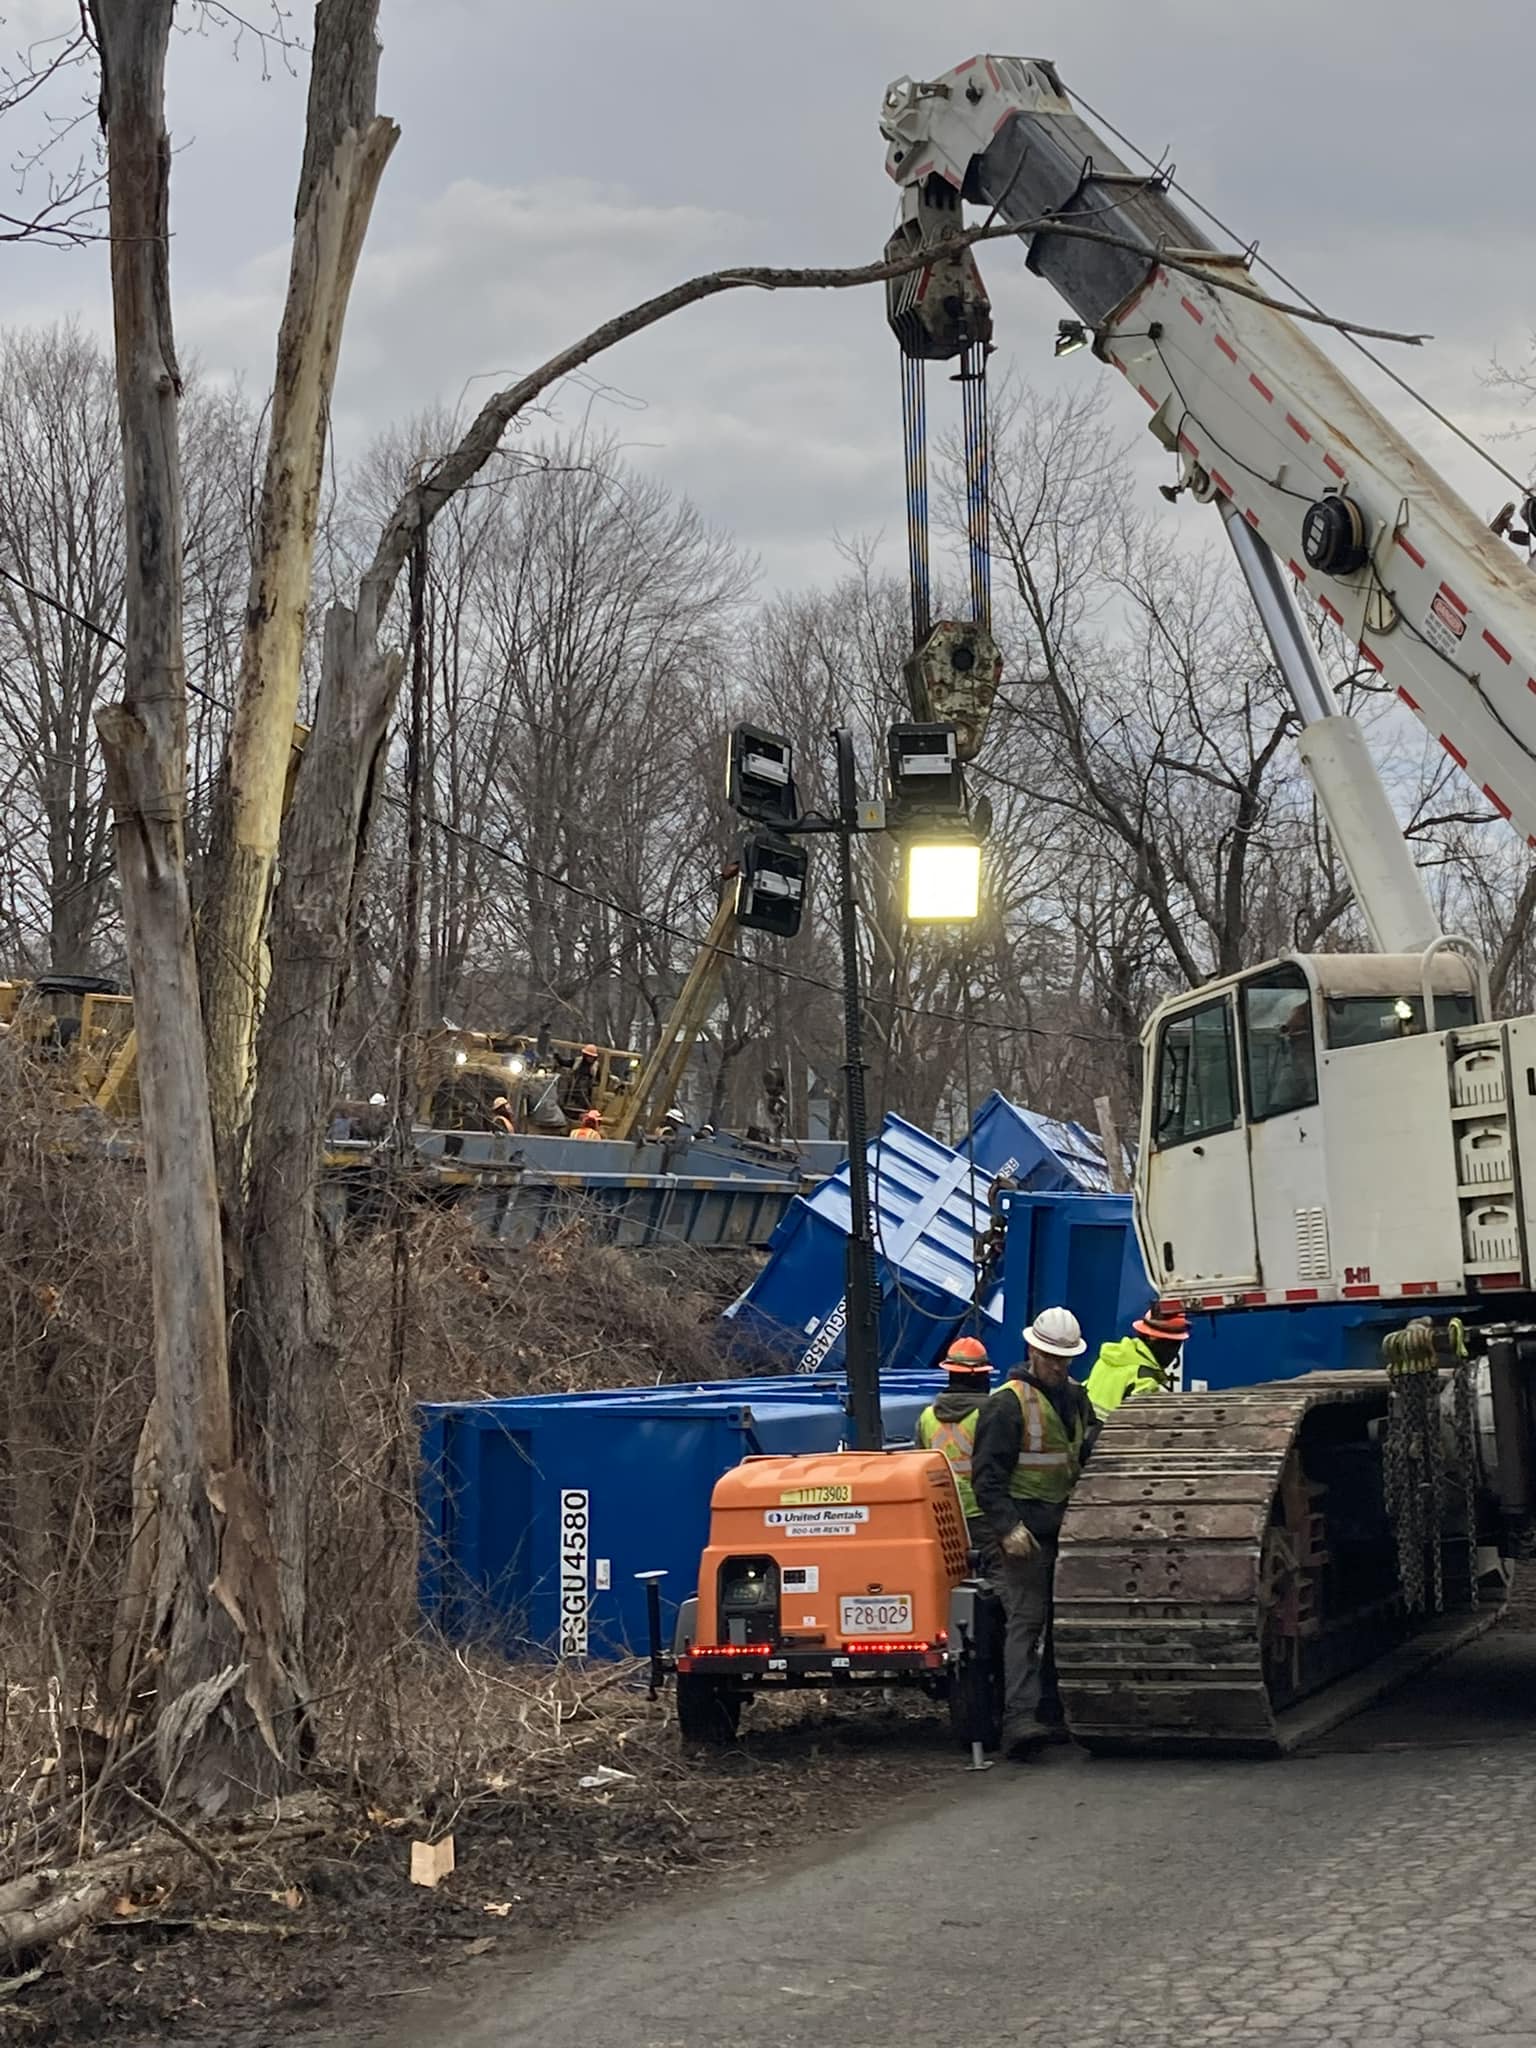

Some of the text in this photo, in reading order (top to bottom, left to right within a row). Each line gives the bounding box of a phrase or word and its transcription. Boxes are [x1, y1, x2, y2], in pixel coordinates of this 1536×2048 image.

[799, 1299, 848, 1374] SGU4582
[784, 1510, 863, 1522] United Rentals
[844, 1606, 909, 1625] F28-029
